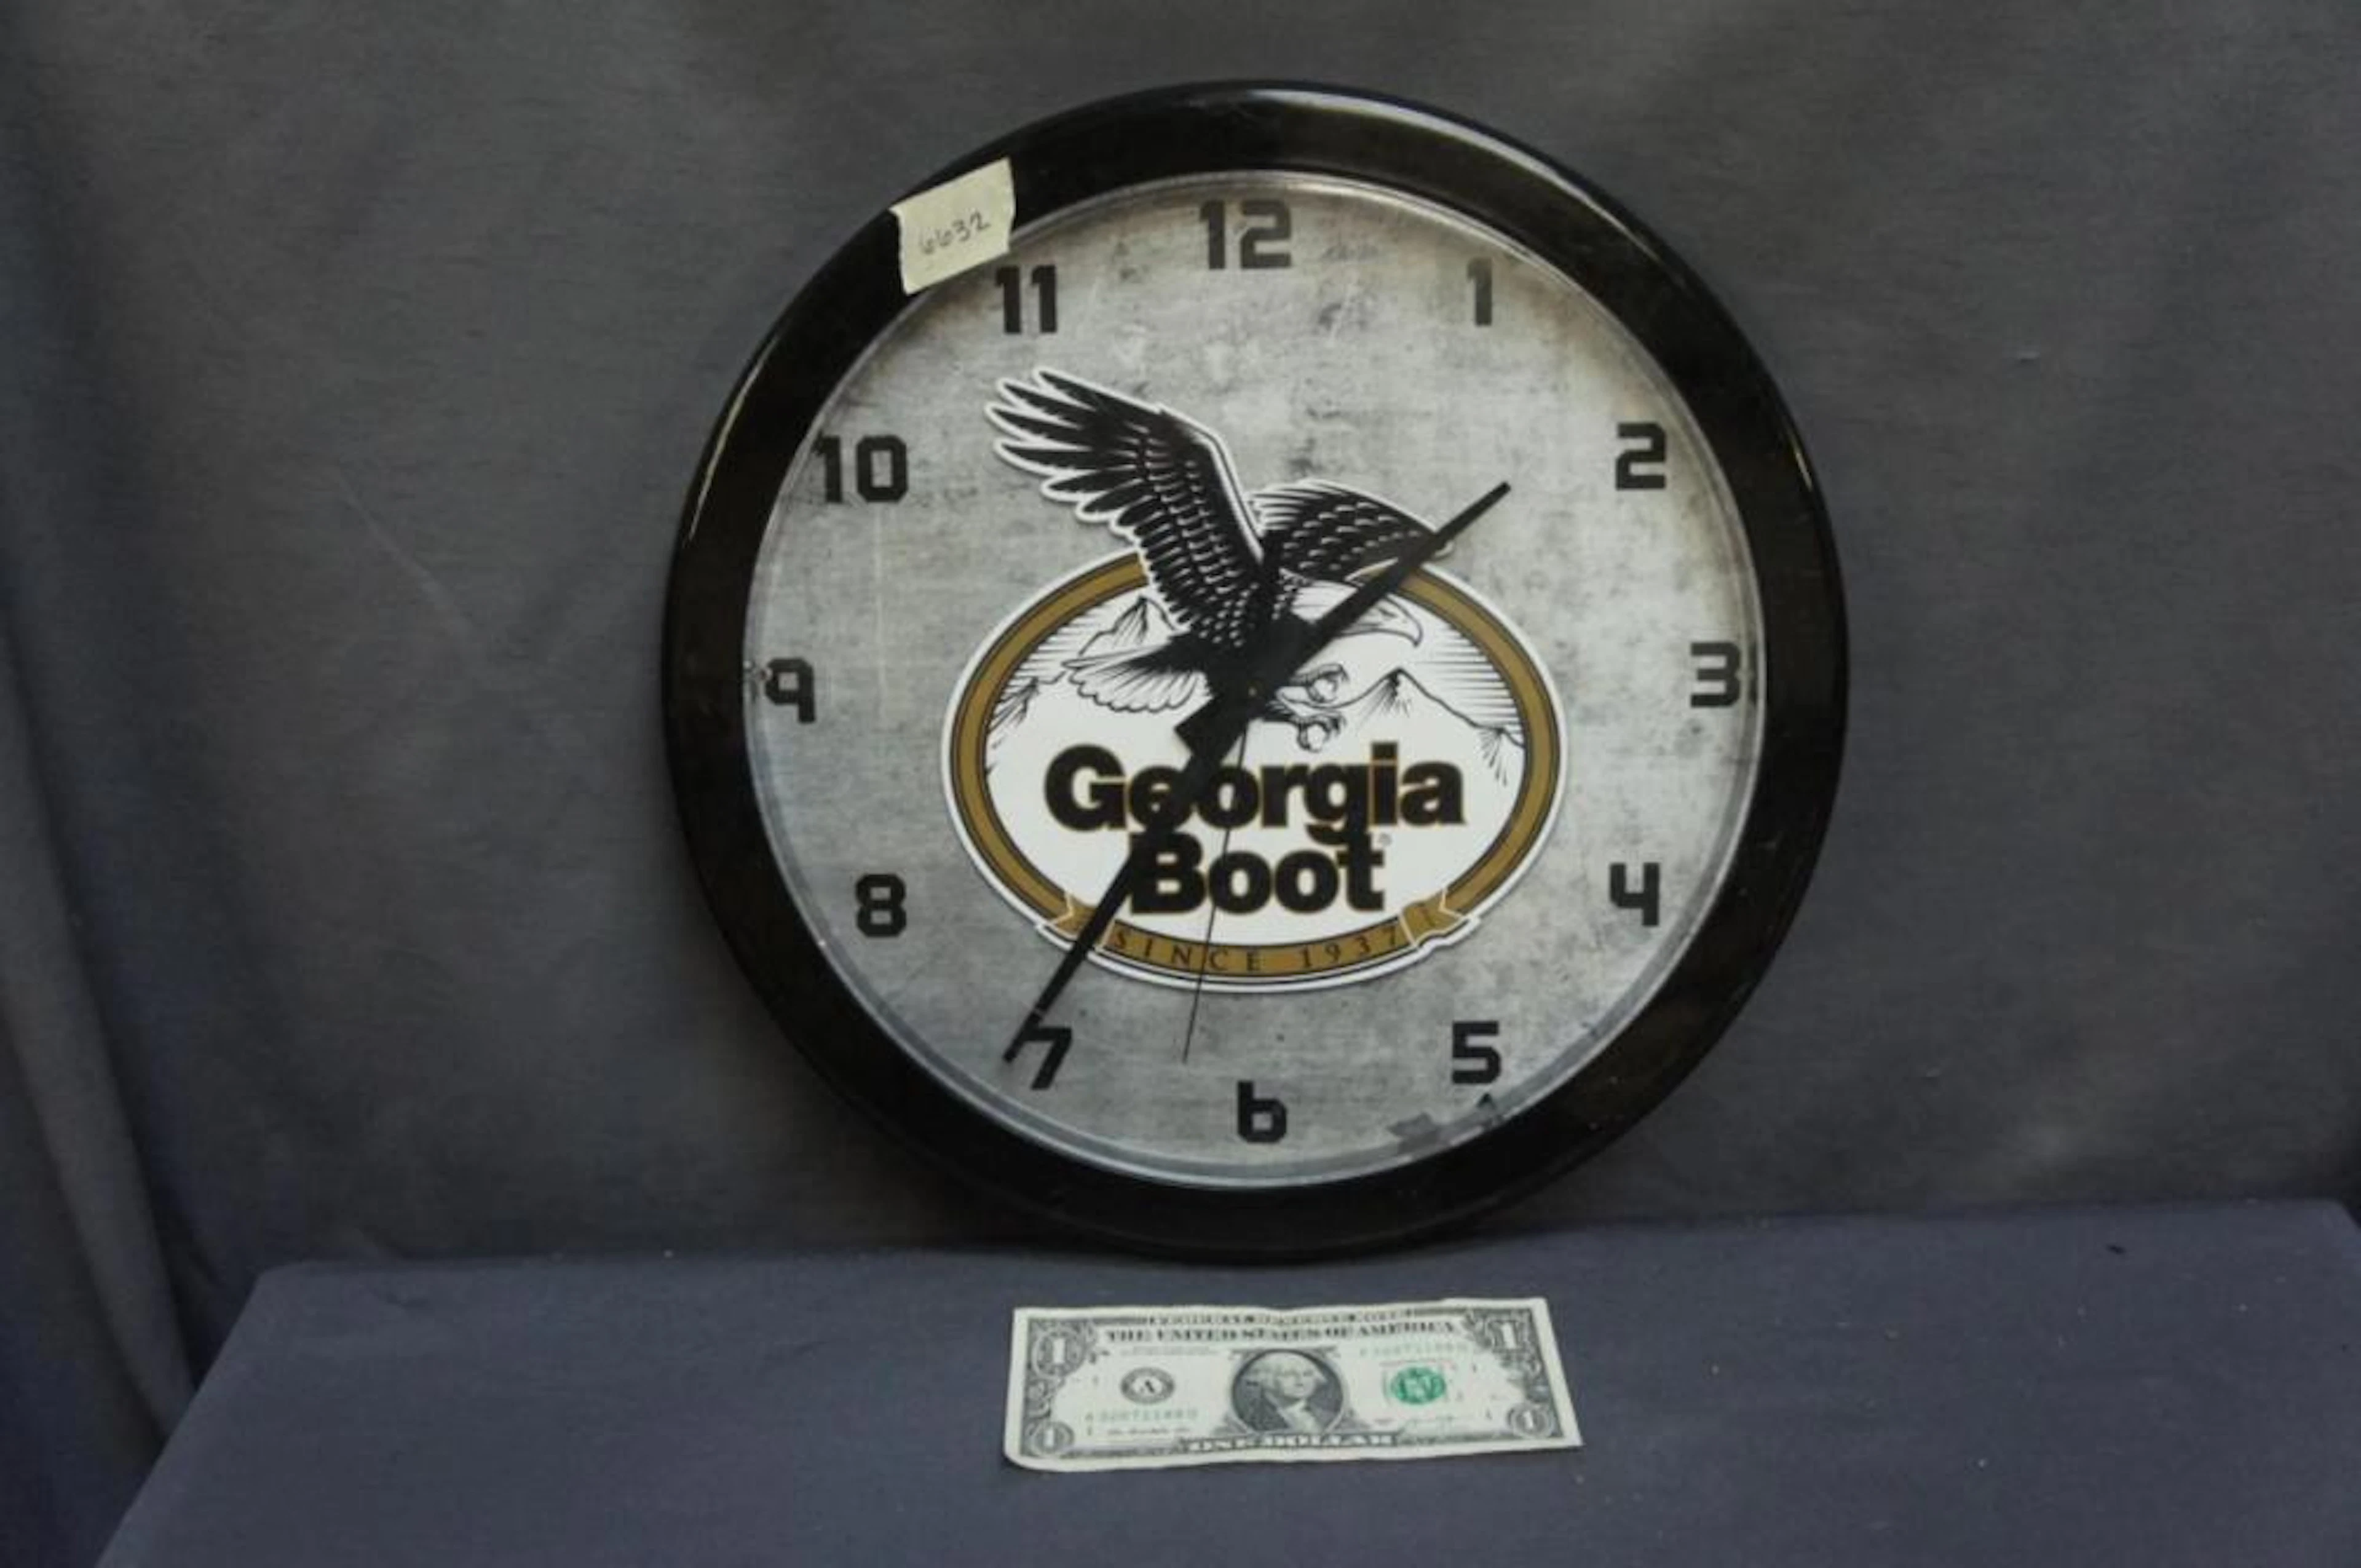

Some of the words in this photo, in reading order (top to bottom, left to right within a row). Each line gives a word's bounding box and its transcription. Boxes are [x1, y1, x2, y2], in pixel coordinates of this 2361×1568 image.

[922, 211, 991, 255] 6632
[1200, 200, 1292, 269] 12
[994, 264, 1058, 334] 11
[1468, 256, 1493, 327] 1
[815, 434, 909, 503] 10
[1615, 422, 1667, 490] 2
[764, 658, 817, 724] 9
[1690, 642, 1742, 708] 3
[1044, 742, 1466, 846] Georgia
[855, 873, 908, 938] 8
[1129, 831, 1386, 915] Boot
[1608, 863, 1660, 927] 4
[1109, 929, 1264, 972] SINCE
[1301, 926, 1398, 968] 1937
[1023, 1026, 1074, 1090] 7
[1452, 1021, 1502, 1085] 5
[1237, 1081, 1287, 1144] 6
